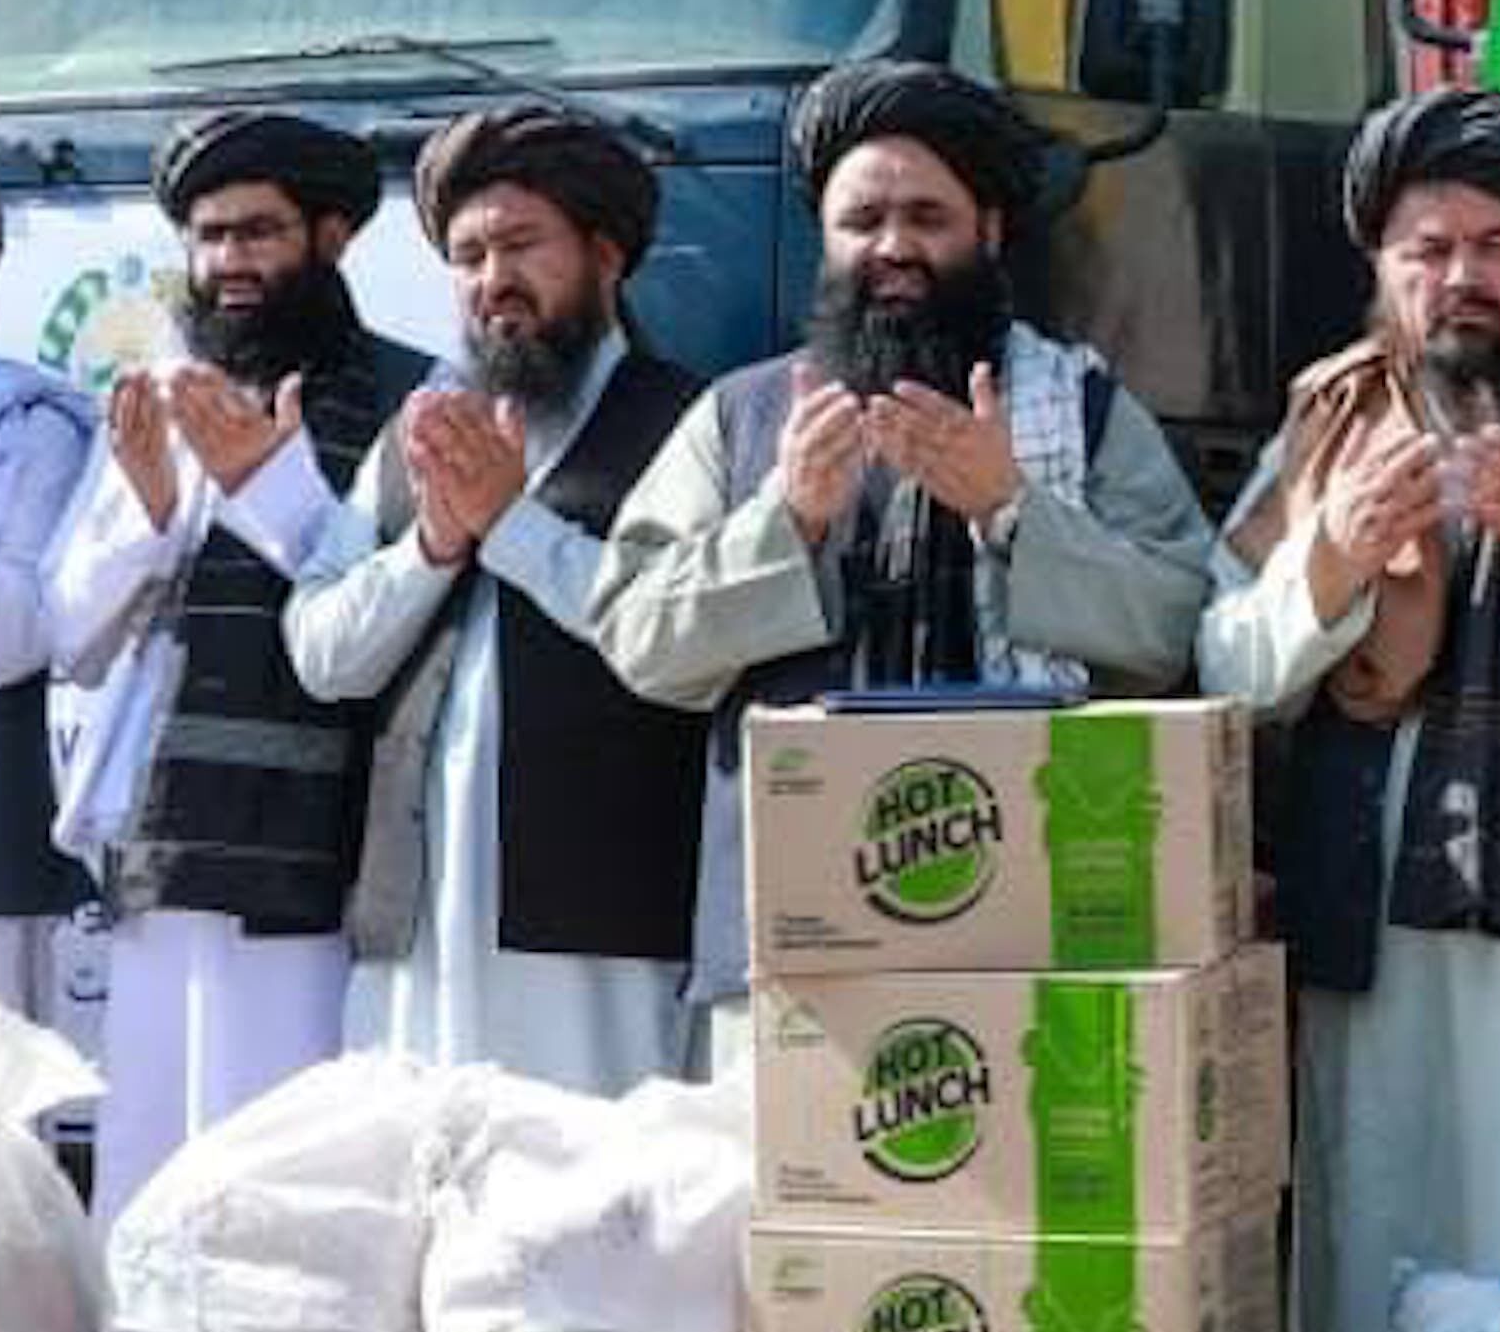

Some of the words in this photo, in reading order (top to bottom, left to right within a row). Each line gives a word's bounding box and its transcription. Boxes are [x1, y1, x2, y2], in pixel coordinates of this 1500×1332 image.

[876, 772, 957, 820] HOT
[854, 804, 1002, 885] LUNCH
[874, 1031, 950, 1076] HOT
[853, 1066, 990, 1142] LUNCH
